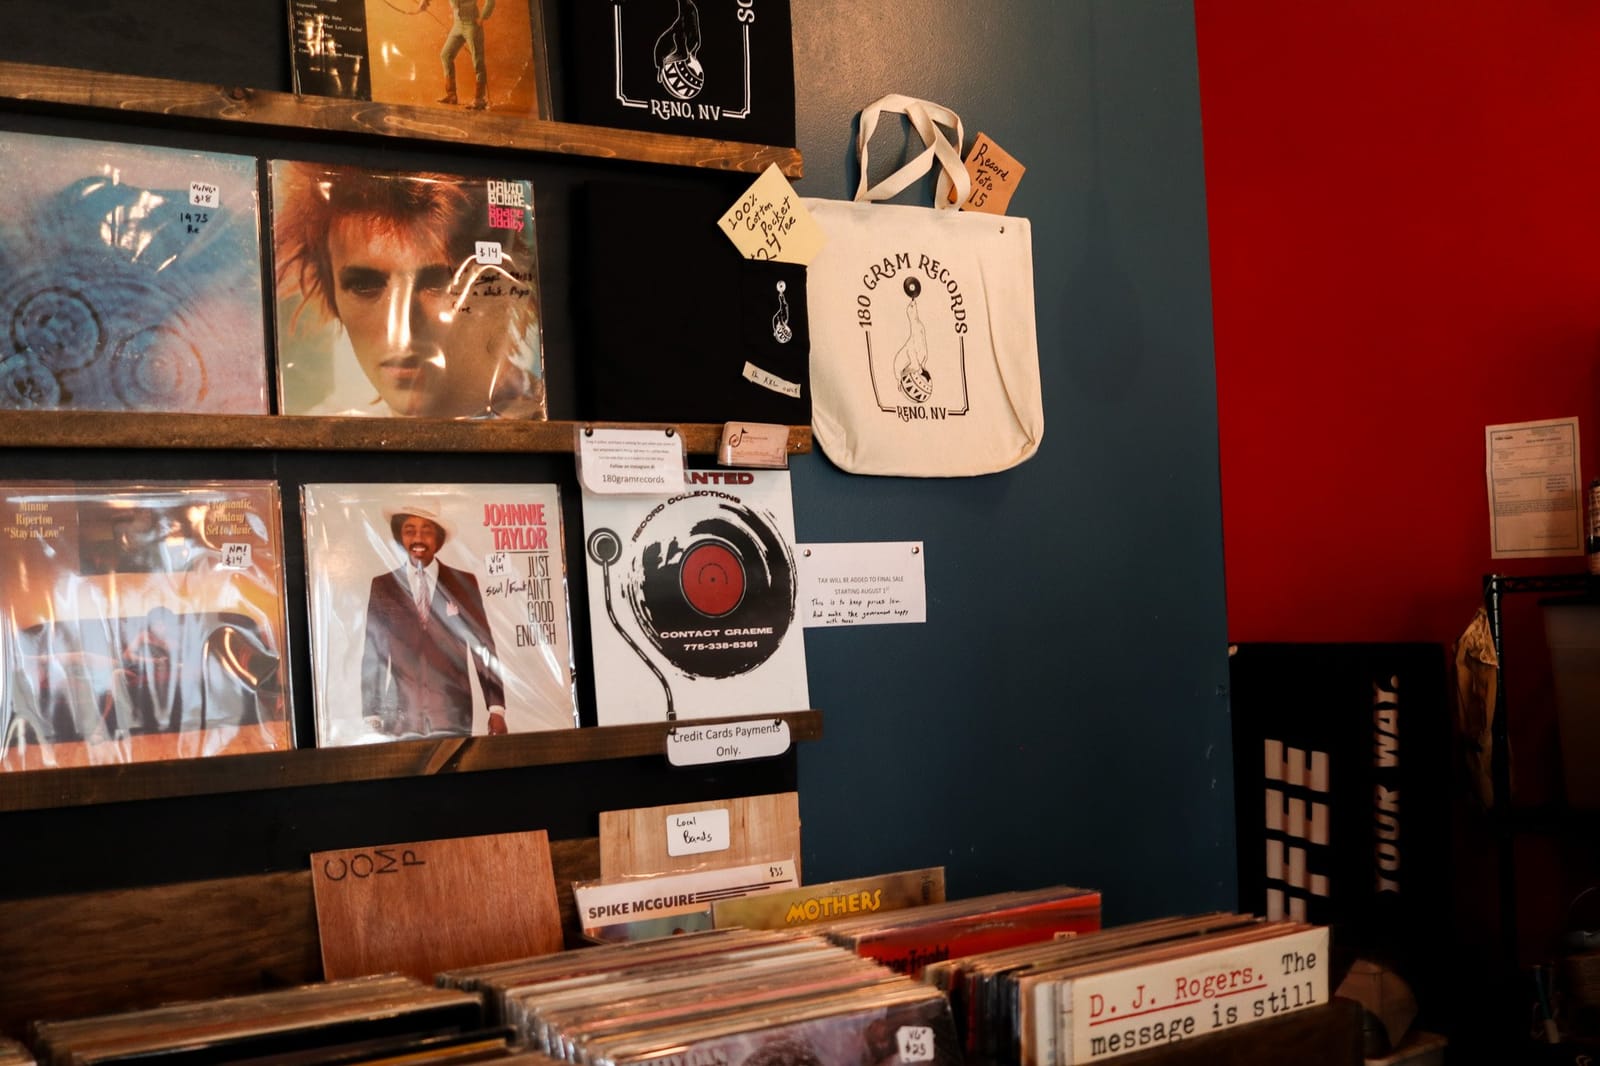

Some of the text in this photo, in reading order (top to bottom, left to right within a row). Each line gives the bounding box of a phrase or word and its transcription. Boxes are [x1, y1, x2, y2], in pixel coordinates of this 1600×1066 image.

[651, 100, 720, 121] RENO, NV
[973, 143, 1009, 181] Record
[487, 180, 524, 195] DAVID
[976, 169, 993, 191] Tote
[488, 192, 525, 208] BOWIE
[969, 188, 988, 207] 15
[728, 193, 758, 230] 100%
[746, 202, 773, 231] Cotton
[760, 195, 790, 237] Pocket
[778, 216, 796, 235] Tee
[480, 247, 498, 258] $14
[857, 253, 968, 334] 180 GRAM RECORDS
[897, 405, 947, 422] RENO, NV
[602, 474, 665, 484] 180gramrecords
[483, 504, 547, 526] JOHNNIE
[632, 490, 741, 542] RECORD COLLECTIONS
[491, 527, 548, 550] TAYLOR
[528, 556, 549, 577] JUST
[527, 578, 551, 600] AIN'T
[527, 601, 554, 623] GOOD
[811, 598, 824, 606] This
[849, 598, 862, 607] keep
[848, 610, 858, 618] the
[516, 624, 557, 647] ENOUGH
[660, 627, 773, 639] CONTACT GRAEME
[684, 641, 758, 651] 775-338-8361
[673, 724, 780, 743] Credit Cards Payments
[716, 745, 741, 757] Only.
[1374, 674, 1400, 895] YOUR WAY.
[676, 817, 697, 827] Local
[683, 830, 712, 844] Bands
[588, 893, 696, 919] SPIKE MCGUIRE
[785, 888, 882, 923] MOTHERS
[1089, 951, 1317, 1018] D. J. Rogers. The
[1091, 981, 1316, 1057] message is still
